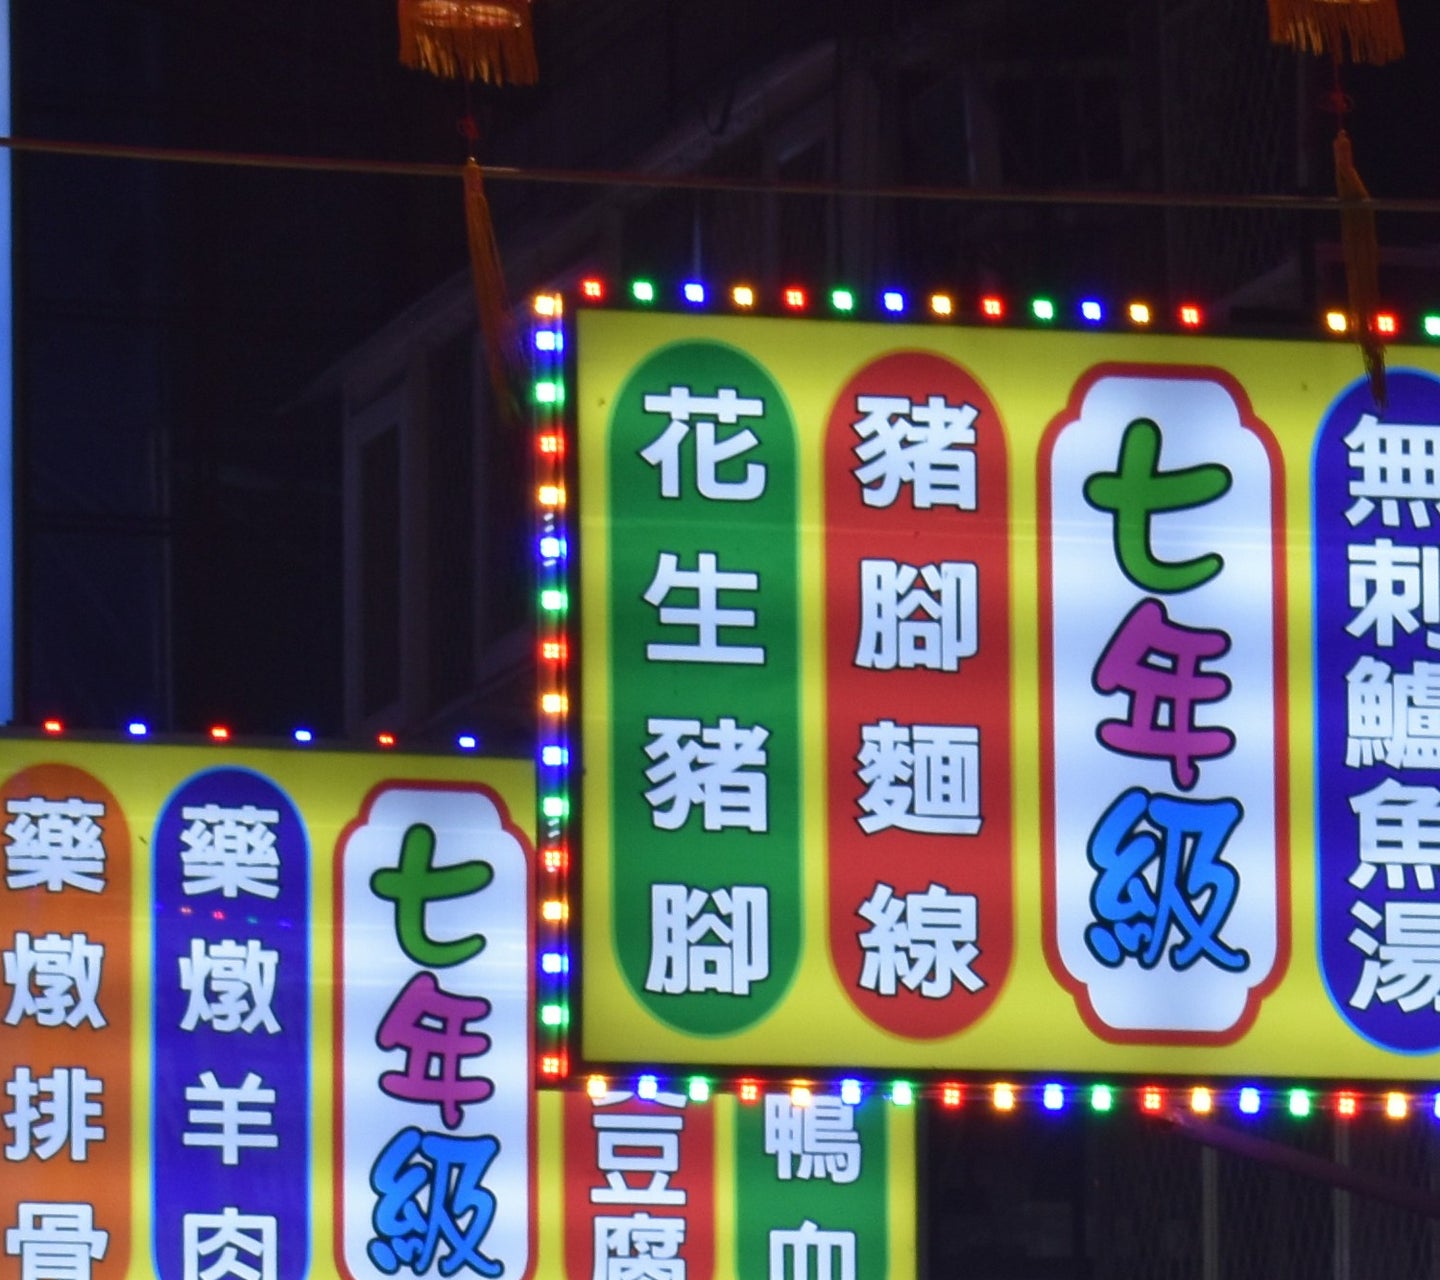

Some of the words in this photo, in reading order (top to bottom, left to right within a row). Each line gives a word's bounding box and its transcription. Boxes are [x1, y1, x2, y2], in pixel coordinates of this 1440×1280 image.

[641, 384, 770, 999] 花生豬腳
[853, 394, 985, 1001] 豬腳麵線
[1082, 416, 1251, 975] 七年級
[369, 822, 503, 1278] 七年級
